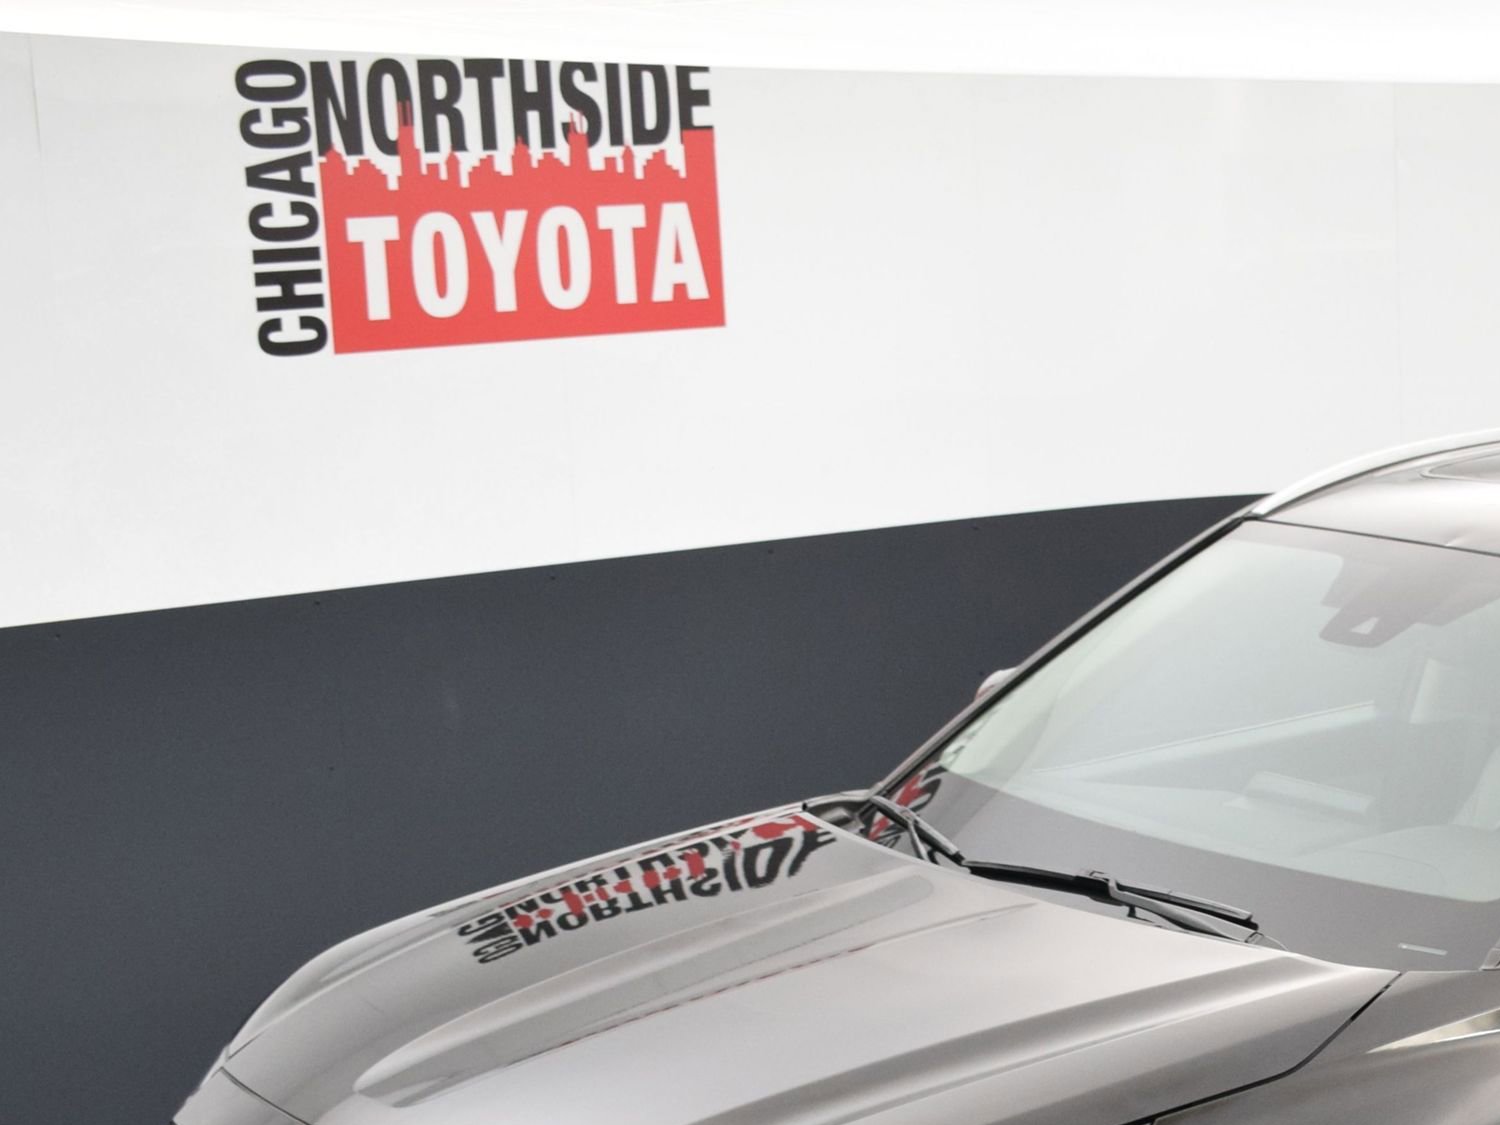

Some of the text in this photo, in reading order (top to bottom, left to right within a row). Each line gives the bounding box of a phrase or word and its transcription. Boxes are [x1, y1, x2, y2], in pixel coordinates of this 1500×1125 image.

[309, 57, 713, 156] NORTHSIDE
[234, 59, 328, 357] CHICAGO
[345, 202, 710, 321] TOYOTA
